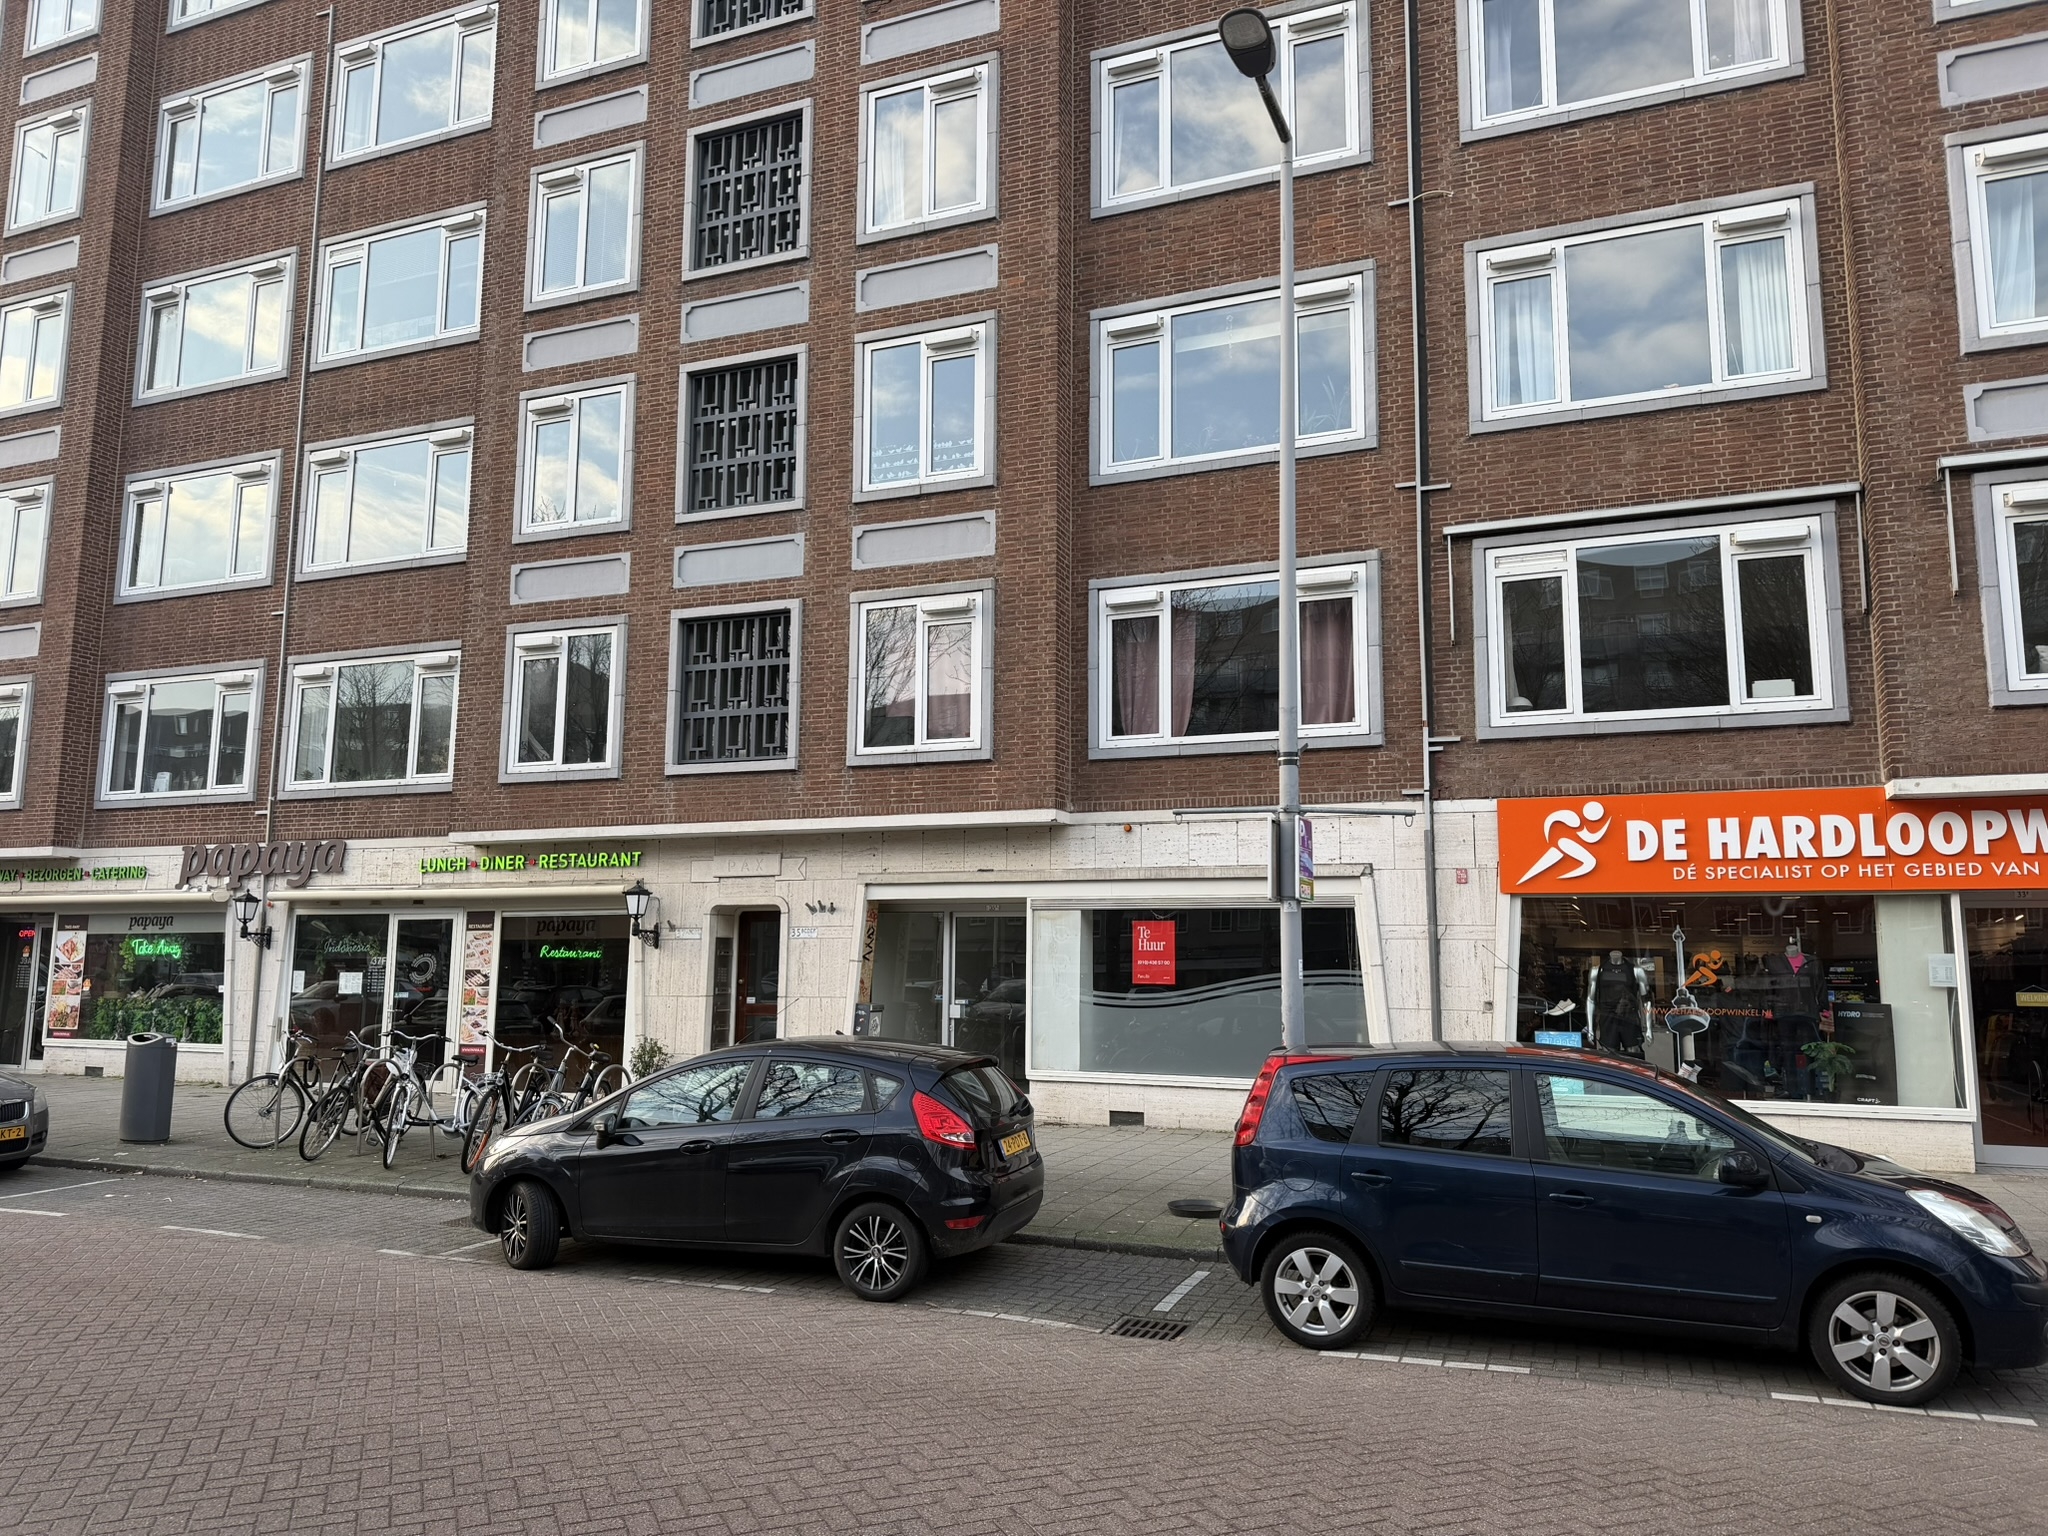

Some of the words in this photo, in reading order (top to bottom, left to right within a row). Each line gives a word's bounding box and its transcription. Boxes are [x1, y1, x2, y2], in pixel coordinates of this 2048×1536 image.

[1626, 818, 1688, 862] DE
[1707, 808, 2048, 860] HARDLOOPW
[175, 840, 346, 889] papaya
[419, 857, 468, 873] LUNCH
[479, 855, 525, 871] DINER
[538, 851, 642, 869] RESTAURANT
[727, 858, 765, 873] PAX
[1673, 863, 1697, 880] DÉ
[1705, 865, 1813, 880] SPECIALIST
[1821, 864, 1850, 878] OP
[1858, 863, 1896, 878] HET
[1904, 862, 1983, 877] GEBIED
[1990, 860, 2040, 876] VAN
[26, 867, 83, 882] BEZORGEN
[91, 865, 147, 880] CATERING
[128, 915, 174, 931] papaya
[535, 919, 596, 936] papaya
[19, 929, 36, 938] OPEN
[1137, 926, 1150, 938] Te
[131, 938, 154, 956] Take
[156, 938, 182, 959] Away
[323, 938, 370, 954] Indonesia
[539, 944, 602, 958] Restaurant
[1138, 939, 1165, 951] Huur
[1838, 1010, 1861, 1018] HYDRO
